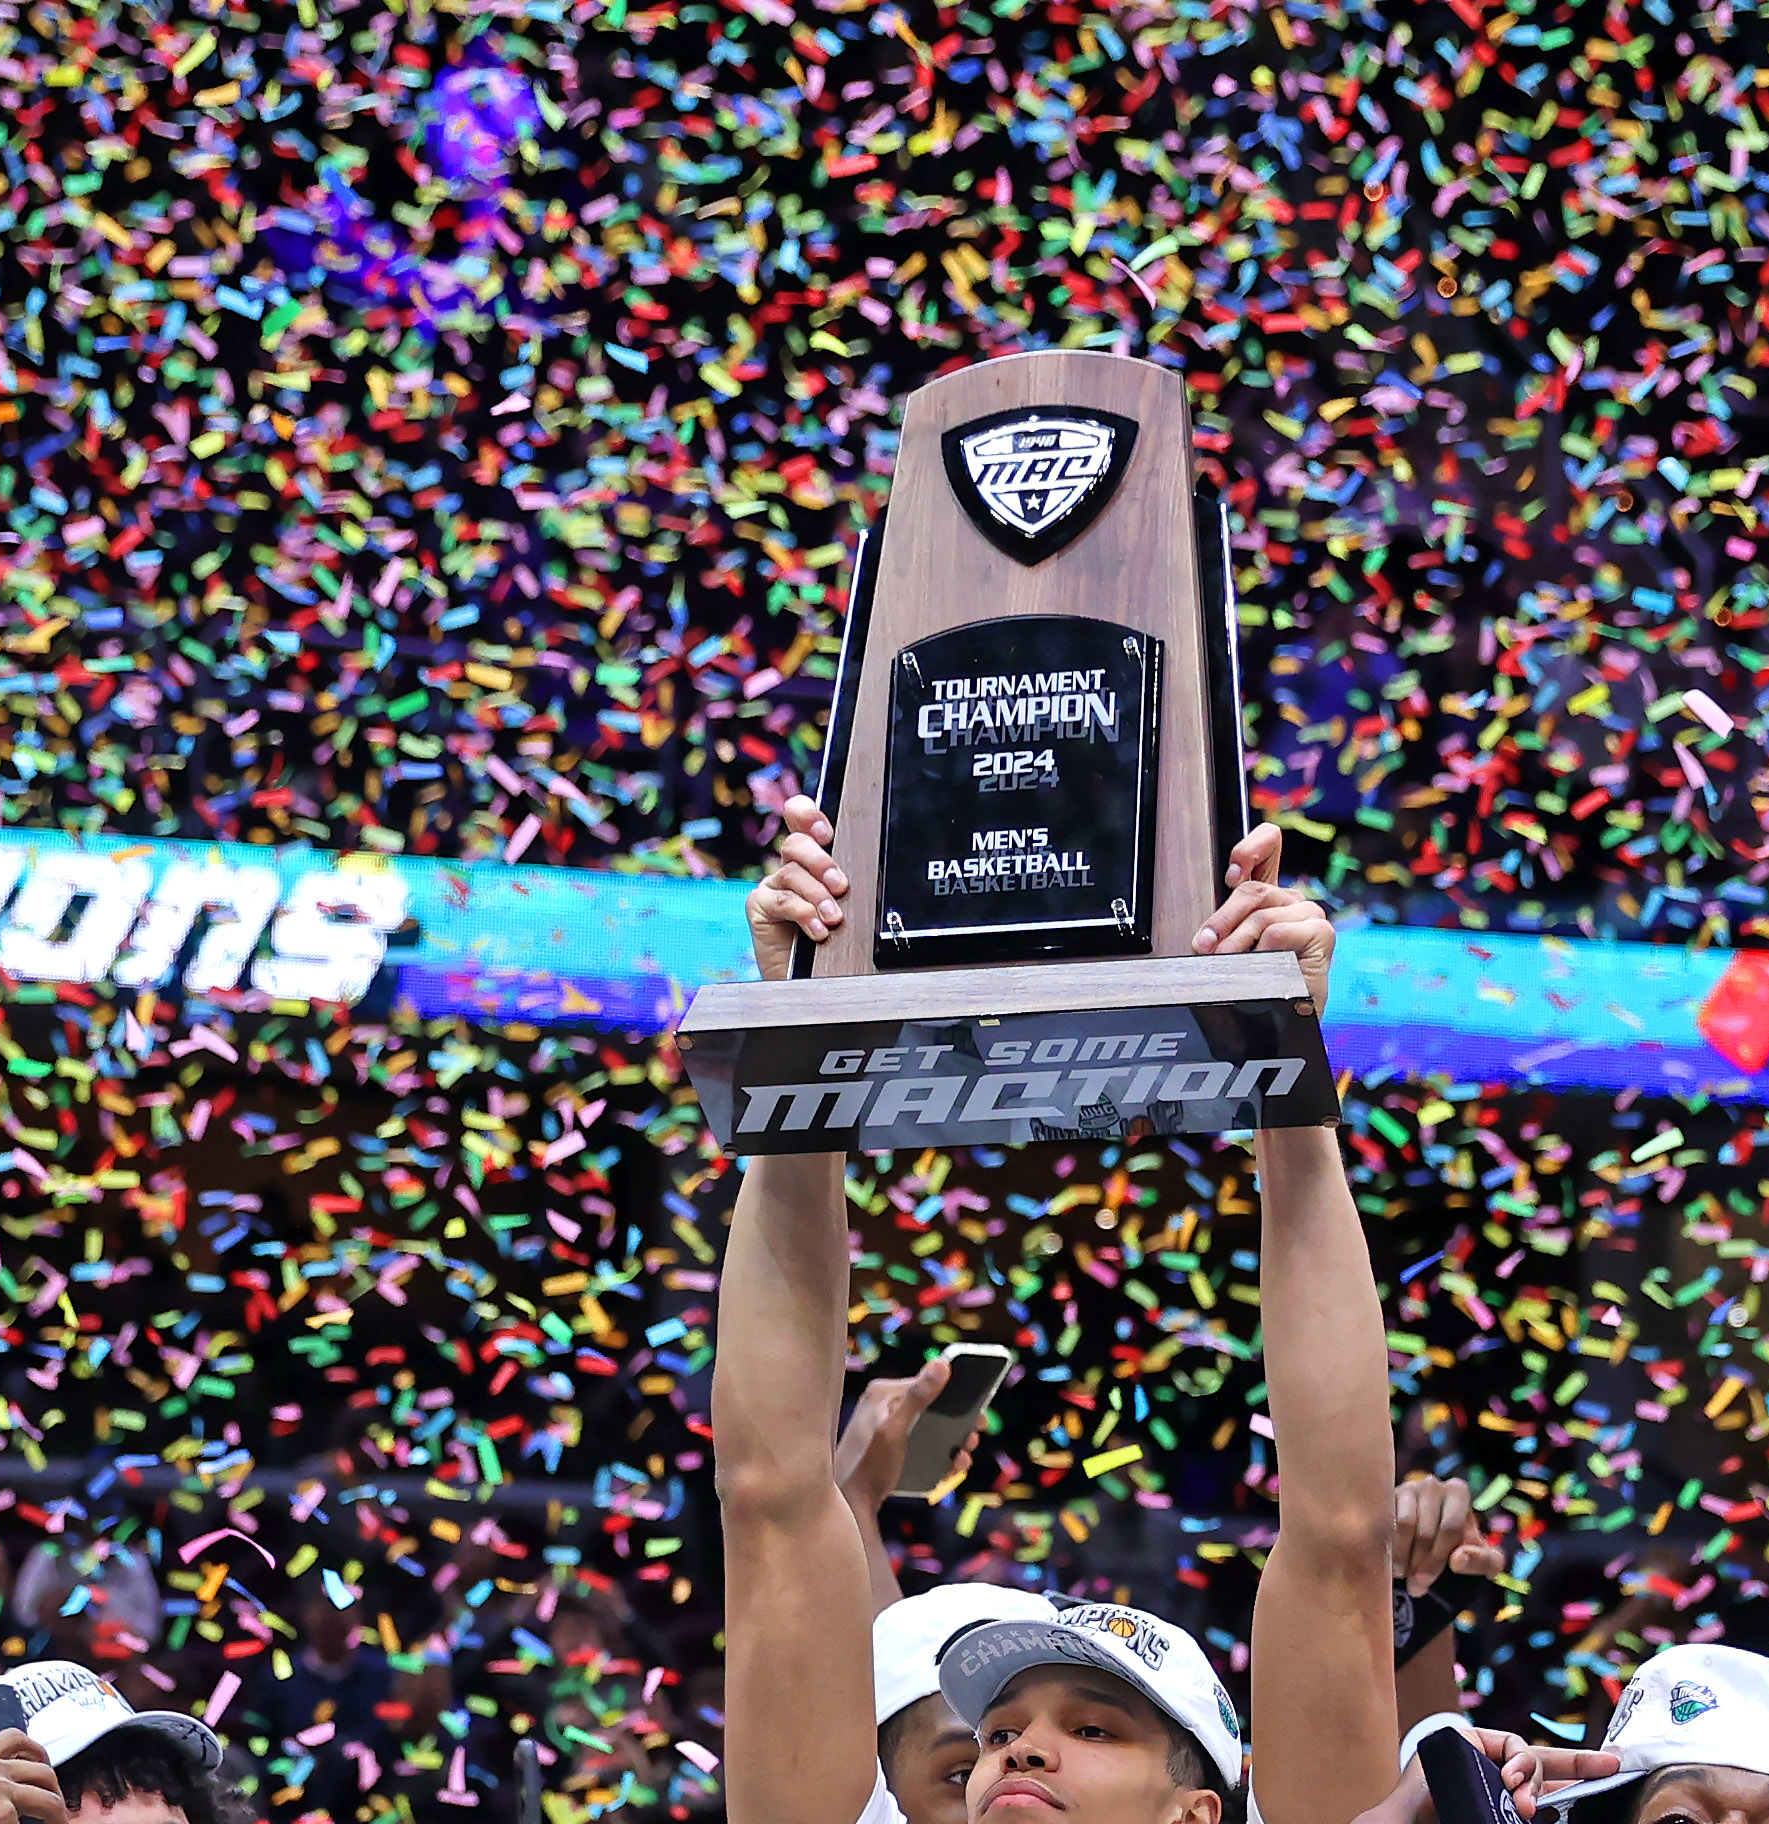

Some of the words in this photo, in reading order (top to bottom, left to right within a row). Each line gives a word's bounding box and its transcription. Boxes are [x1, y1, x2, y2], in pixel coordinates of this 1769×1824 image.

[975, 454, 1100, 487] MAC
[931, 669, 1106, 700] TOURNAMENT
[917, 691, 1116, 739] CHAMPION
[972, 749, 1055, 777] 2024
[972, 828, 1049, 851] MEN'S
[927, 851, 1091, 880] BASKETBALL
[818, 1044, 954, 1075] GET
[984, 1031, 1187, 1066] SOME
[735, 1057, 1308, 1133] MACTION
